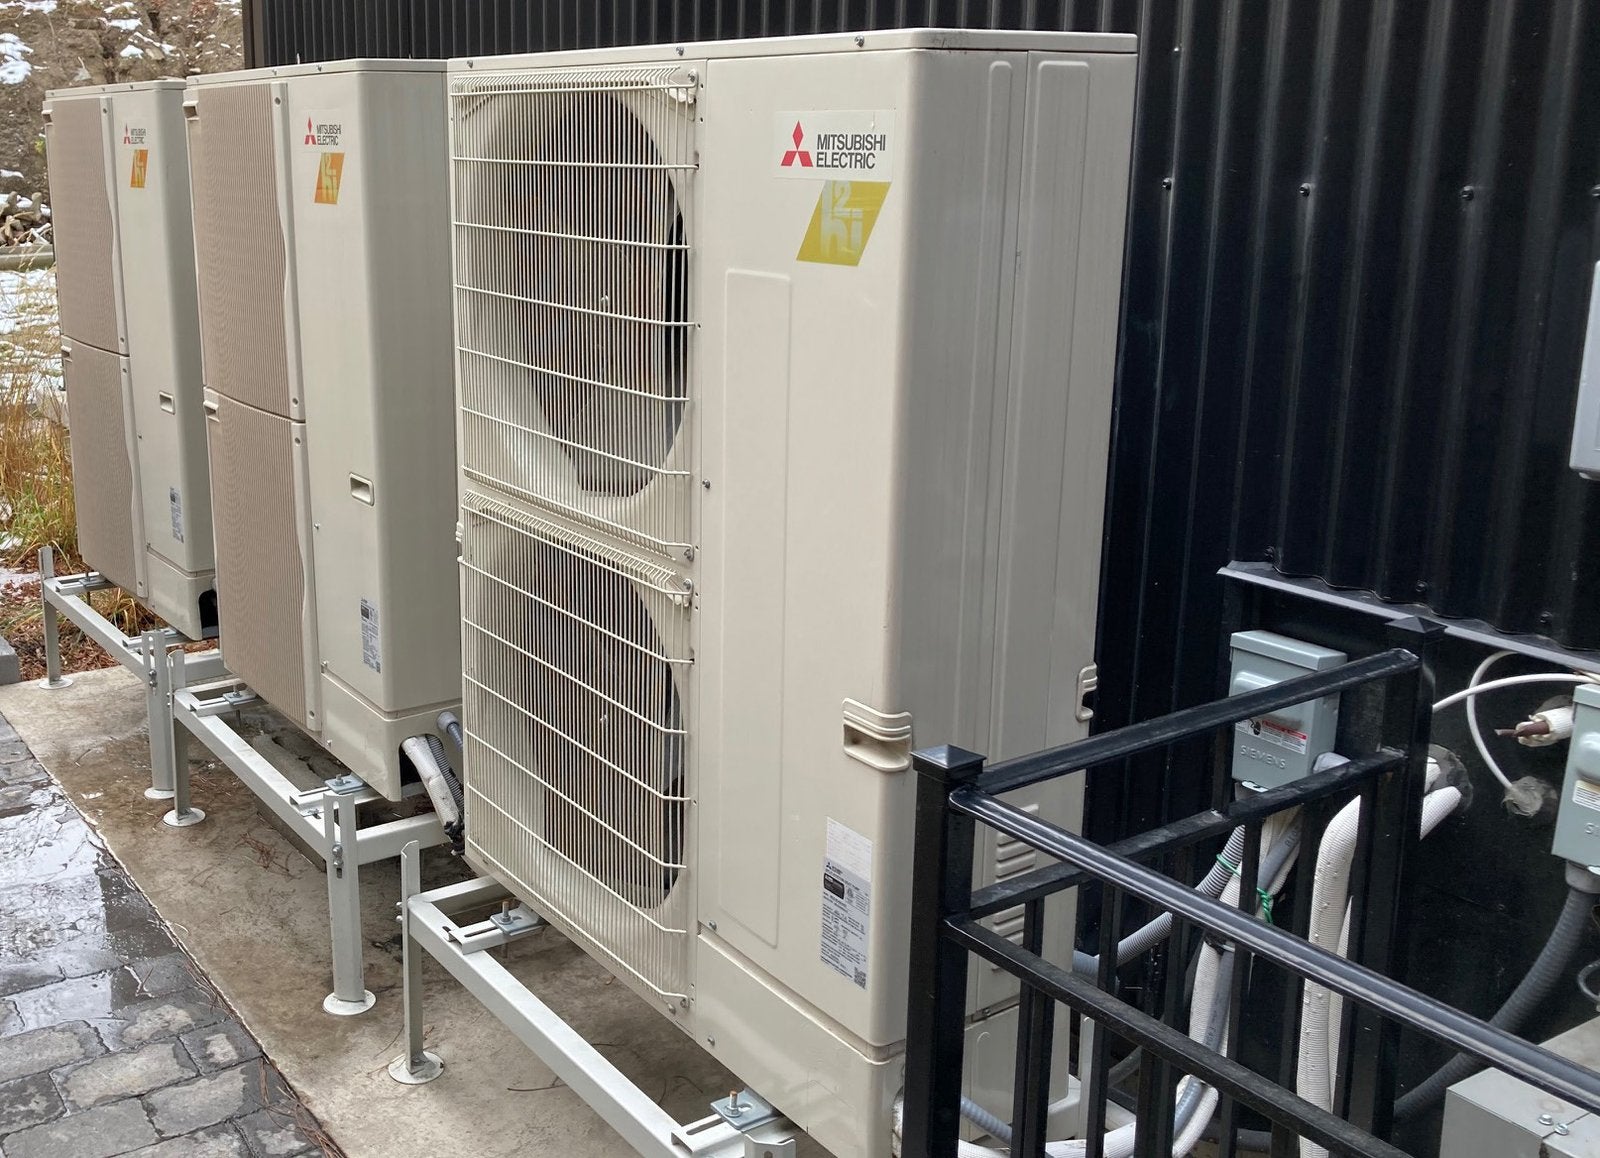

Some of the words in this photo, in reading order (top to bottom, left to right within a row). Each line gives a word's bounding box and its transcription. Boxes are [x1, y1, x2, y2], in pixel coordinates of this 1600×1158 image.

[316, 124, 342, 135] MITSUBISHI
[317, 135, 339, 146] ELECTRIC
[816, 133, 886, 151] MITSUBISHI
[816, 151, 876, 169] ELECTRIC
[1240, 744, 1286, 770] SIEMENS
